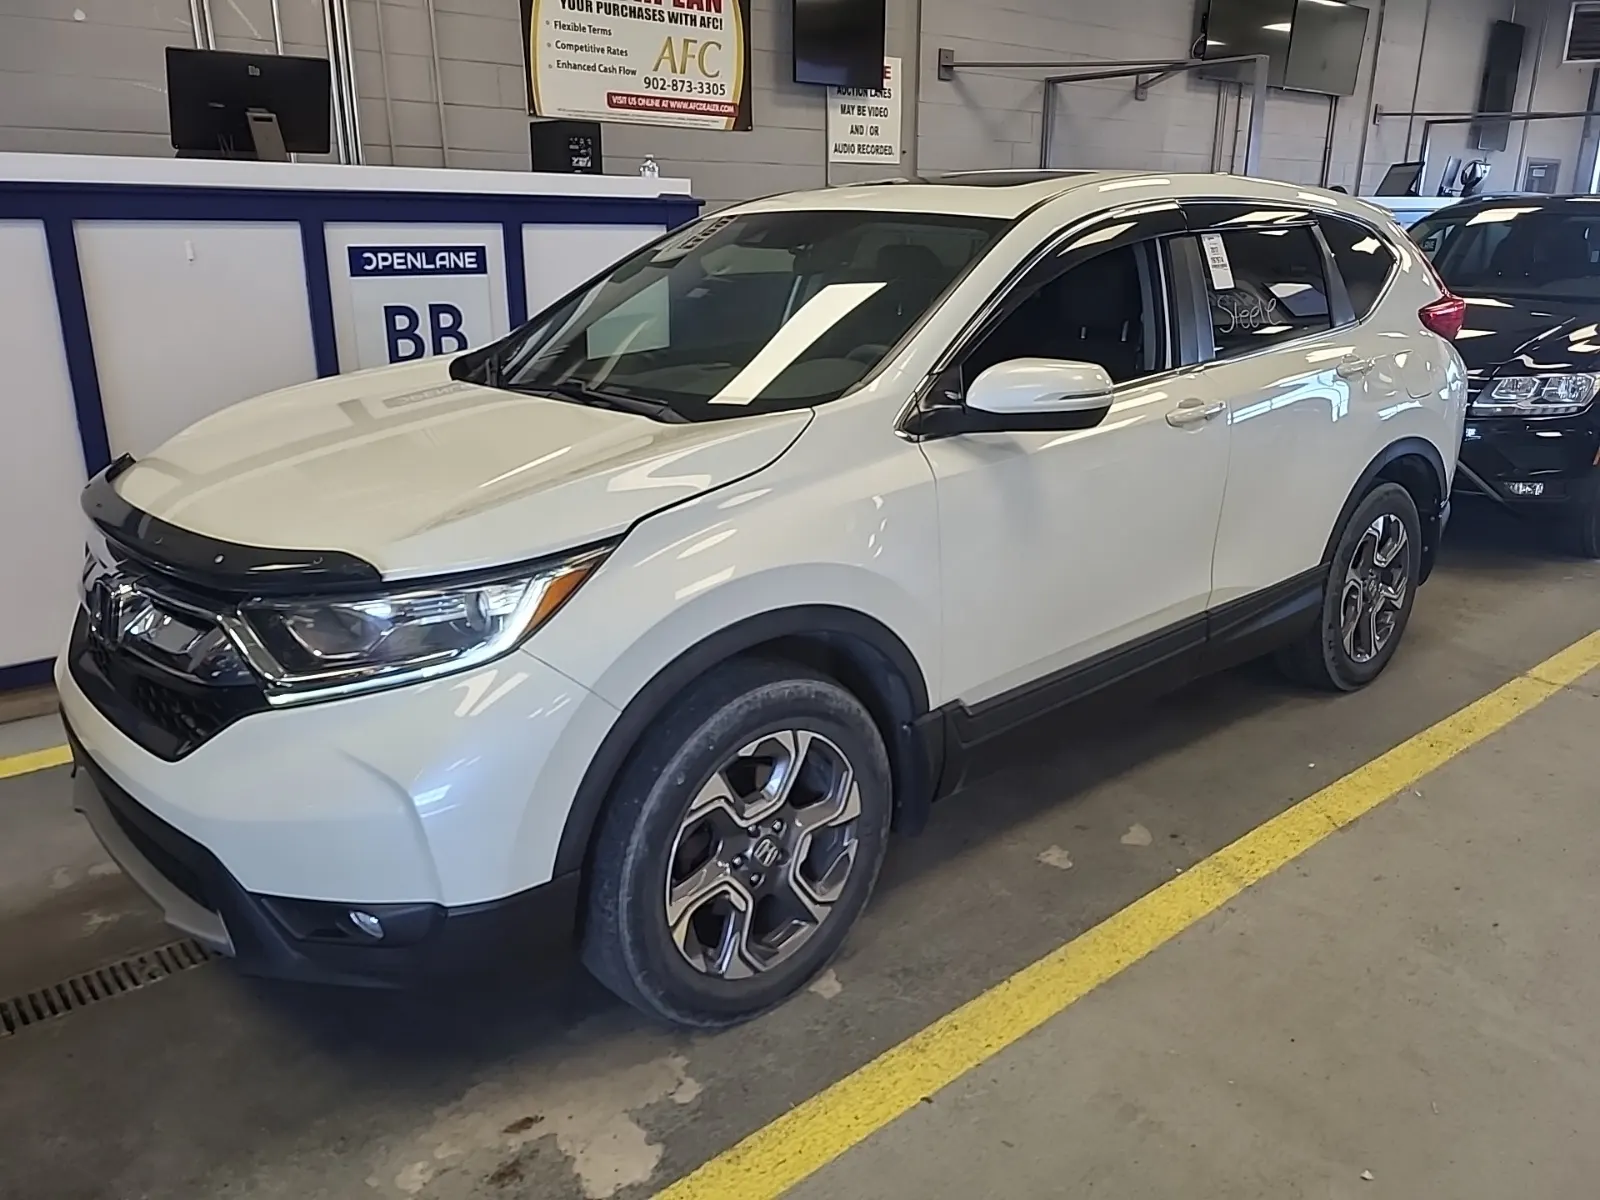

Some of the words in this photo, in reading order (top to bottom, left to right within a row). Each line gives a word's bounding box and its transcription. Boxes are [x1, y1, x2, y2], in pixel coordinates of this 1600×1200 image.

[560, 0, 593, 13] YOUR
[596, 2, 665, 23] PURCHASES
[667, 11, 697, 27] WITH
[700, 16, 723, 31] AFC!
[554, 20, 587, 33] Flexible
[587, 25, 612, 36] Terms
[555, 40, 605, 54] Competitive
[606, 46, 628, 57] Rates
[652, 35, 722, 78] AFC
[556, 60, 597, 72] Enhanced
[598, 64, 617, 74] Cash
[618, 66, 637, 76] Flow
[643, 76, 726, 96] 902-873-3305
[611, 95, 628, 105] VISIT
[628, 97, 637, 106] US
[637, 98, 661, 108] ONLINE
[661, 99, 669, 108] AT
[840, 104, 856, 115] MAY
[857, 105, 867, 116] BE
[867, 106, 889, 118] VIDEO
[849, 124, 865, 135] AND
[869, 125, 880, 136] OR
[833, 143, 856, 154] AUDIO
[857, 144, 895, 156] RECORDED.
[362, 251, 478, 271] OPENLANE
[383, 303, 469, 364] BB
